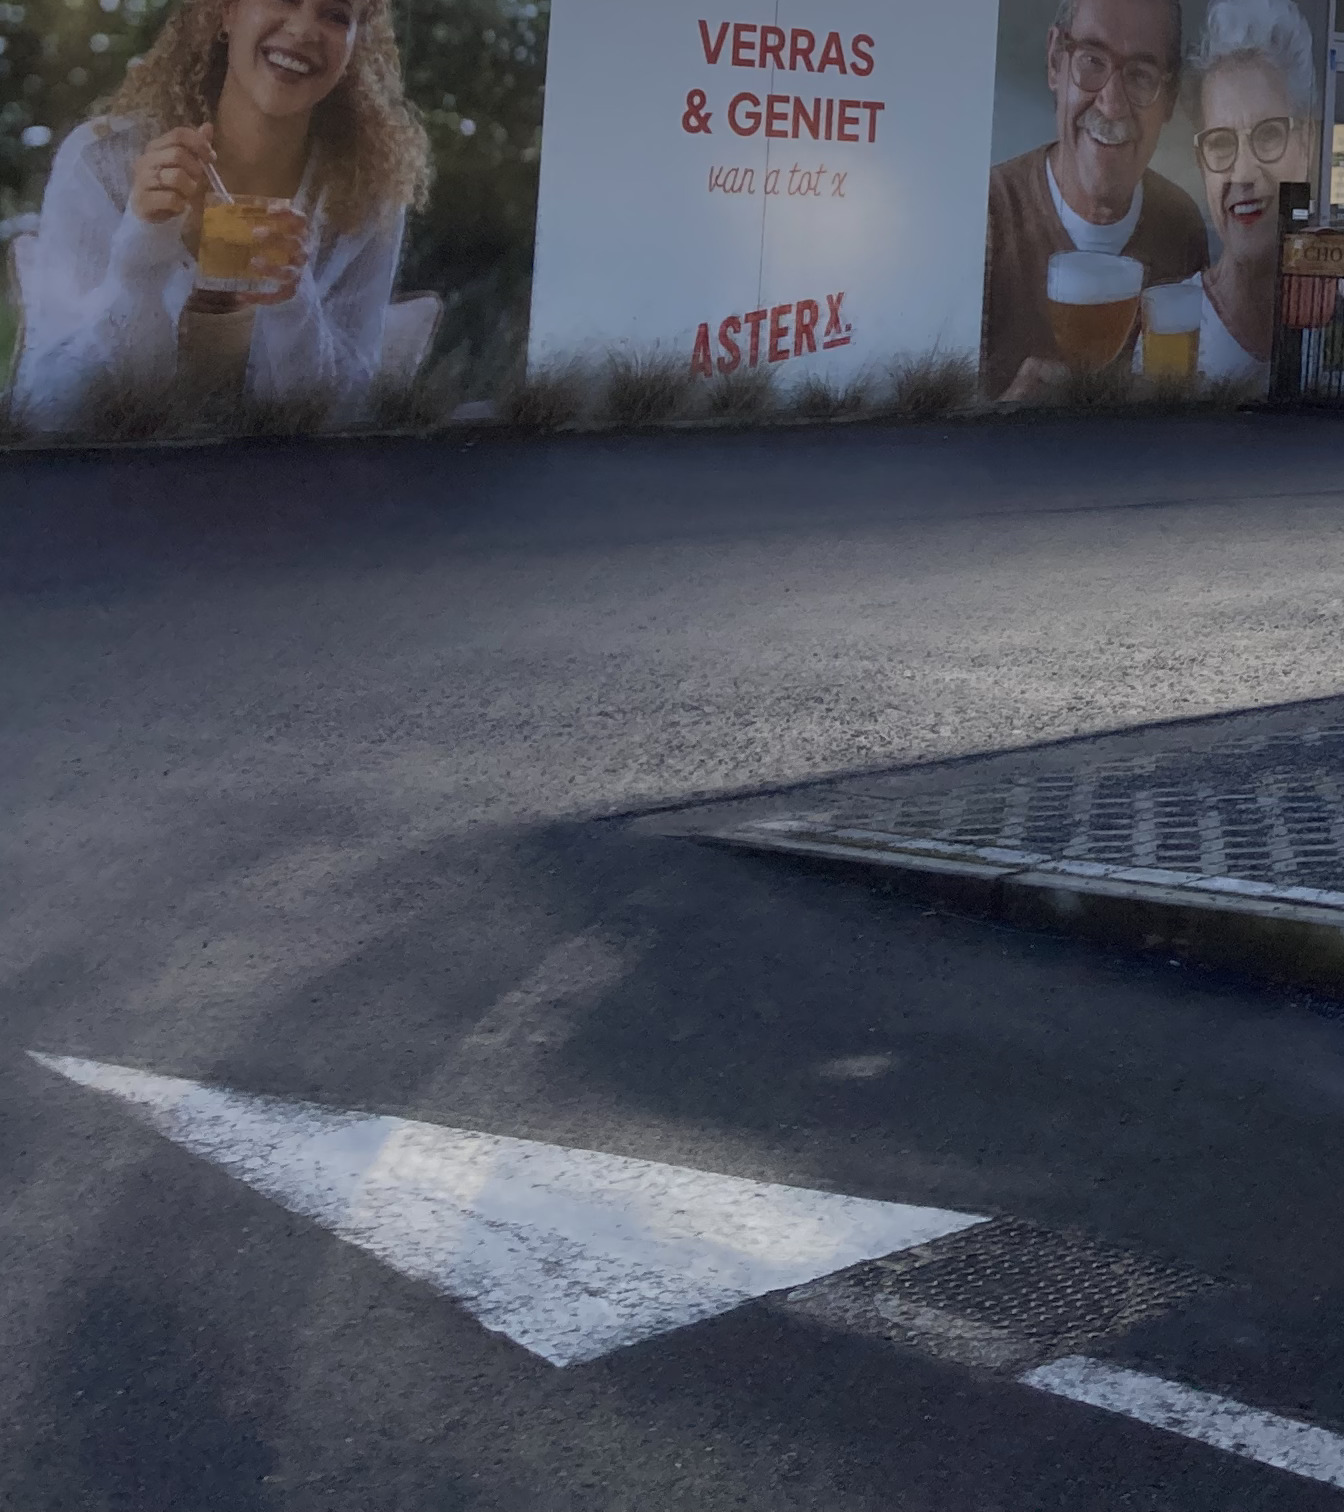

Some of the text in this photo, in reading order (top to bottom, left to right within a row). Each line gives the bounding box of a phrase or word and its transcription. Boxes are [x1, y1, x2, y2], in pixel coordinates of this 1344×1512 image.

[698, 20, 875, 76] VERRAS
[682, 88, 885, 143] & GENIET
[708, 162, 848, 197] van a tot x
